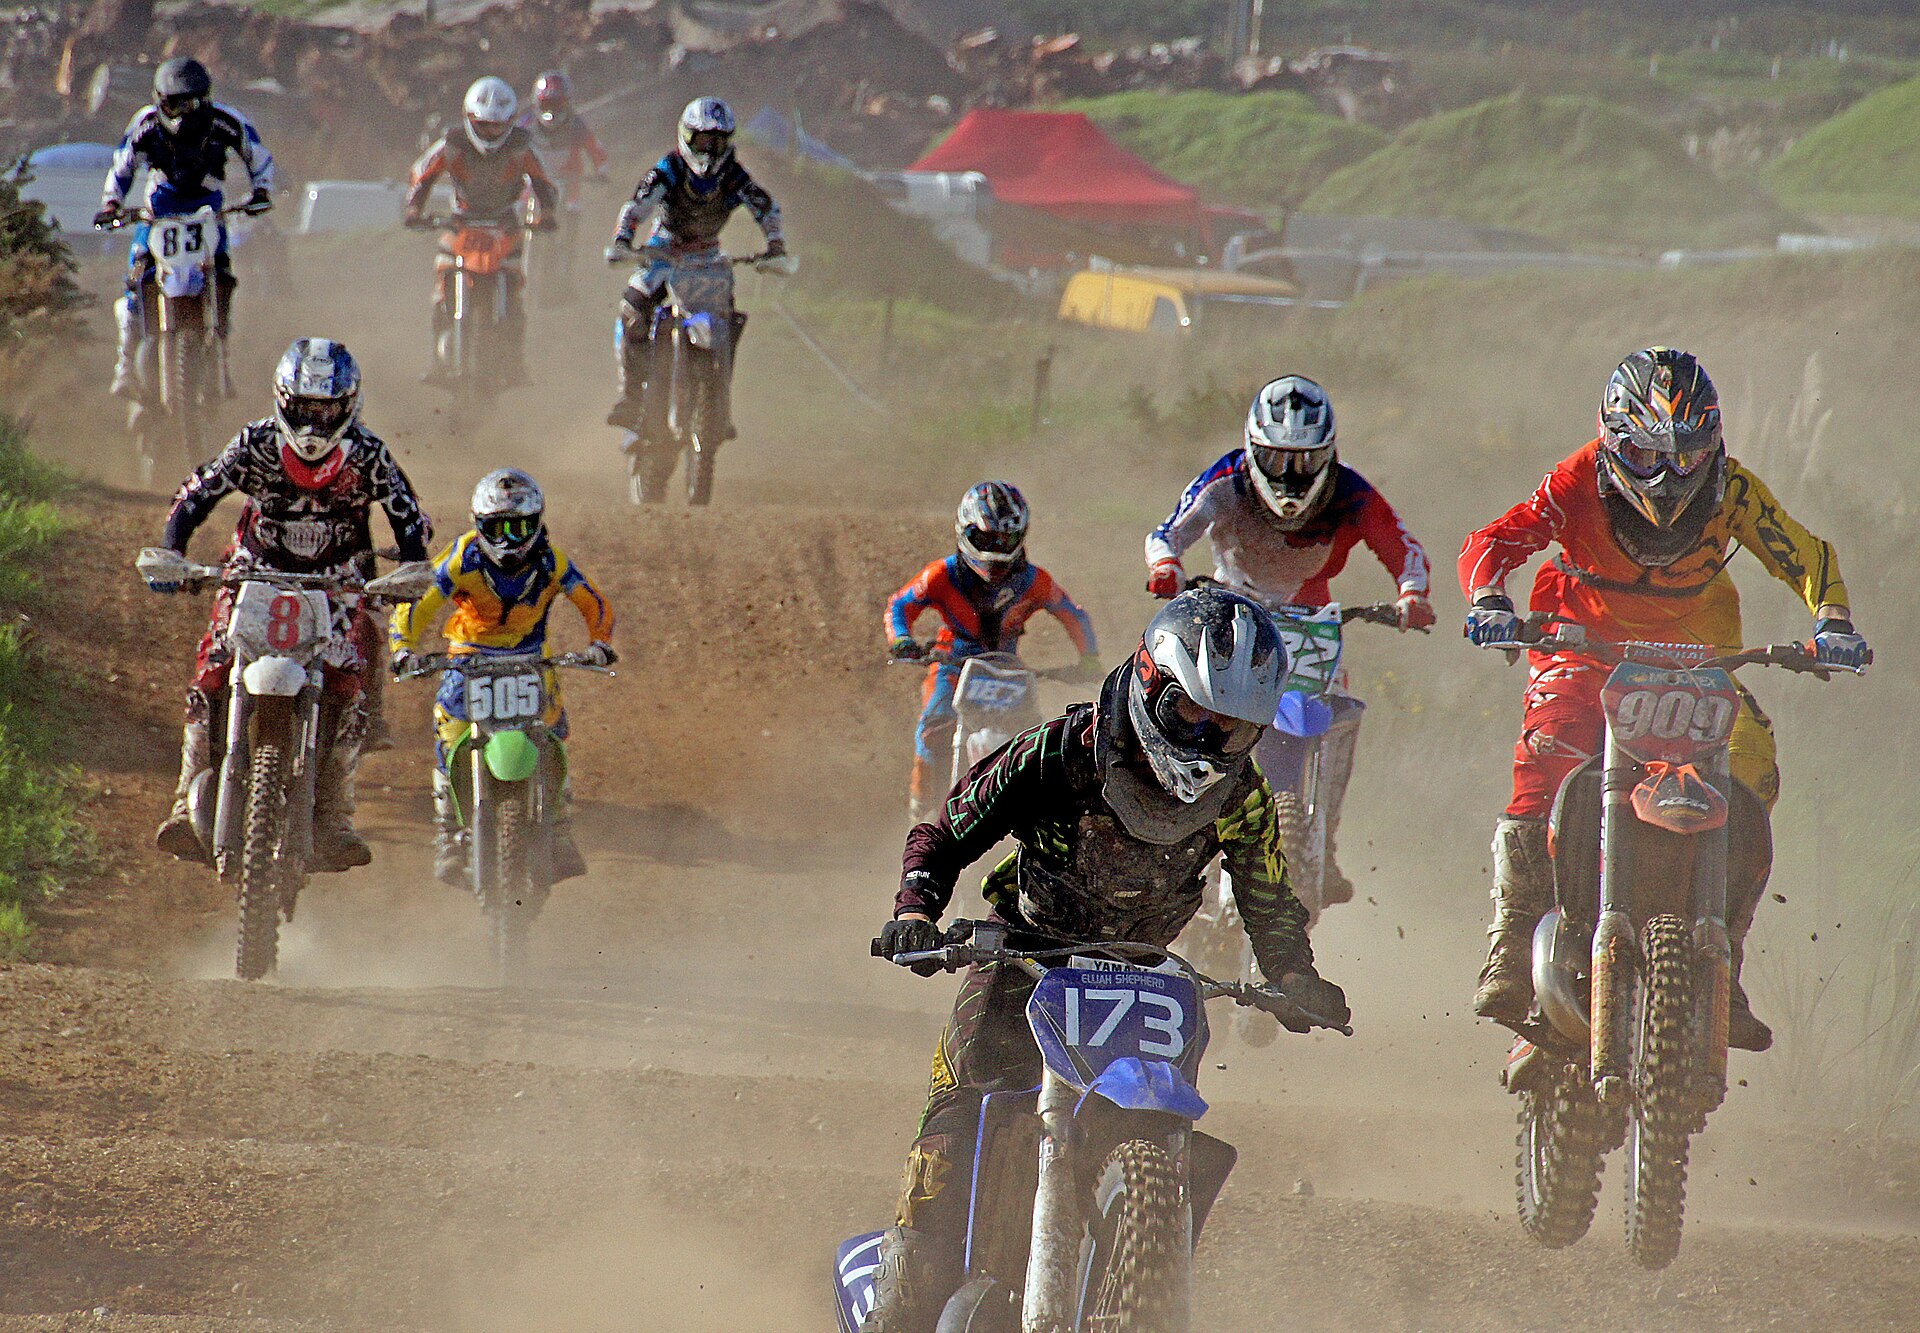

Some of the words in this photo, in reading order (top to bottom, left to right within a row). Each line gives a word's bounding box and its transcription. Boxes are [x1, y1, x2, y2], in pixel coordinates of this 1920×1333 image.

[163, 222, 203, 257] 83
[267, 595, 301, 651] 8
[469, 674, 541, 721] 505
[1612, 690, 1734, 741] 909
[1081, 973, 1112, 985] ELIJAH
[1115, 974, 1165, 988] SHEPHERD
[1093, 960, 1149, 972] YAMA
[1064, 987, 1185, 1058] 173
